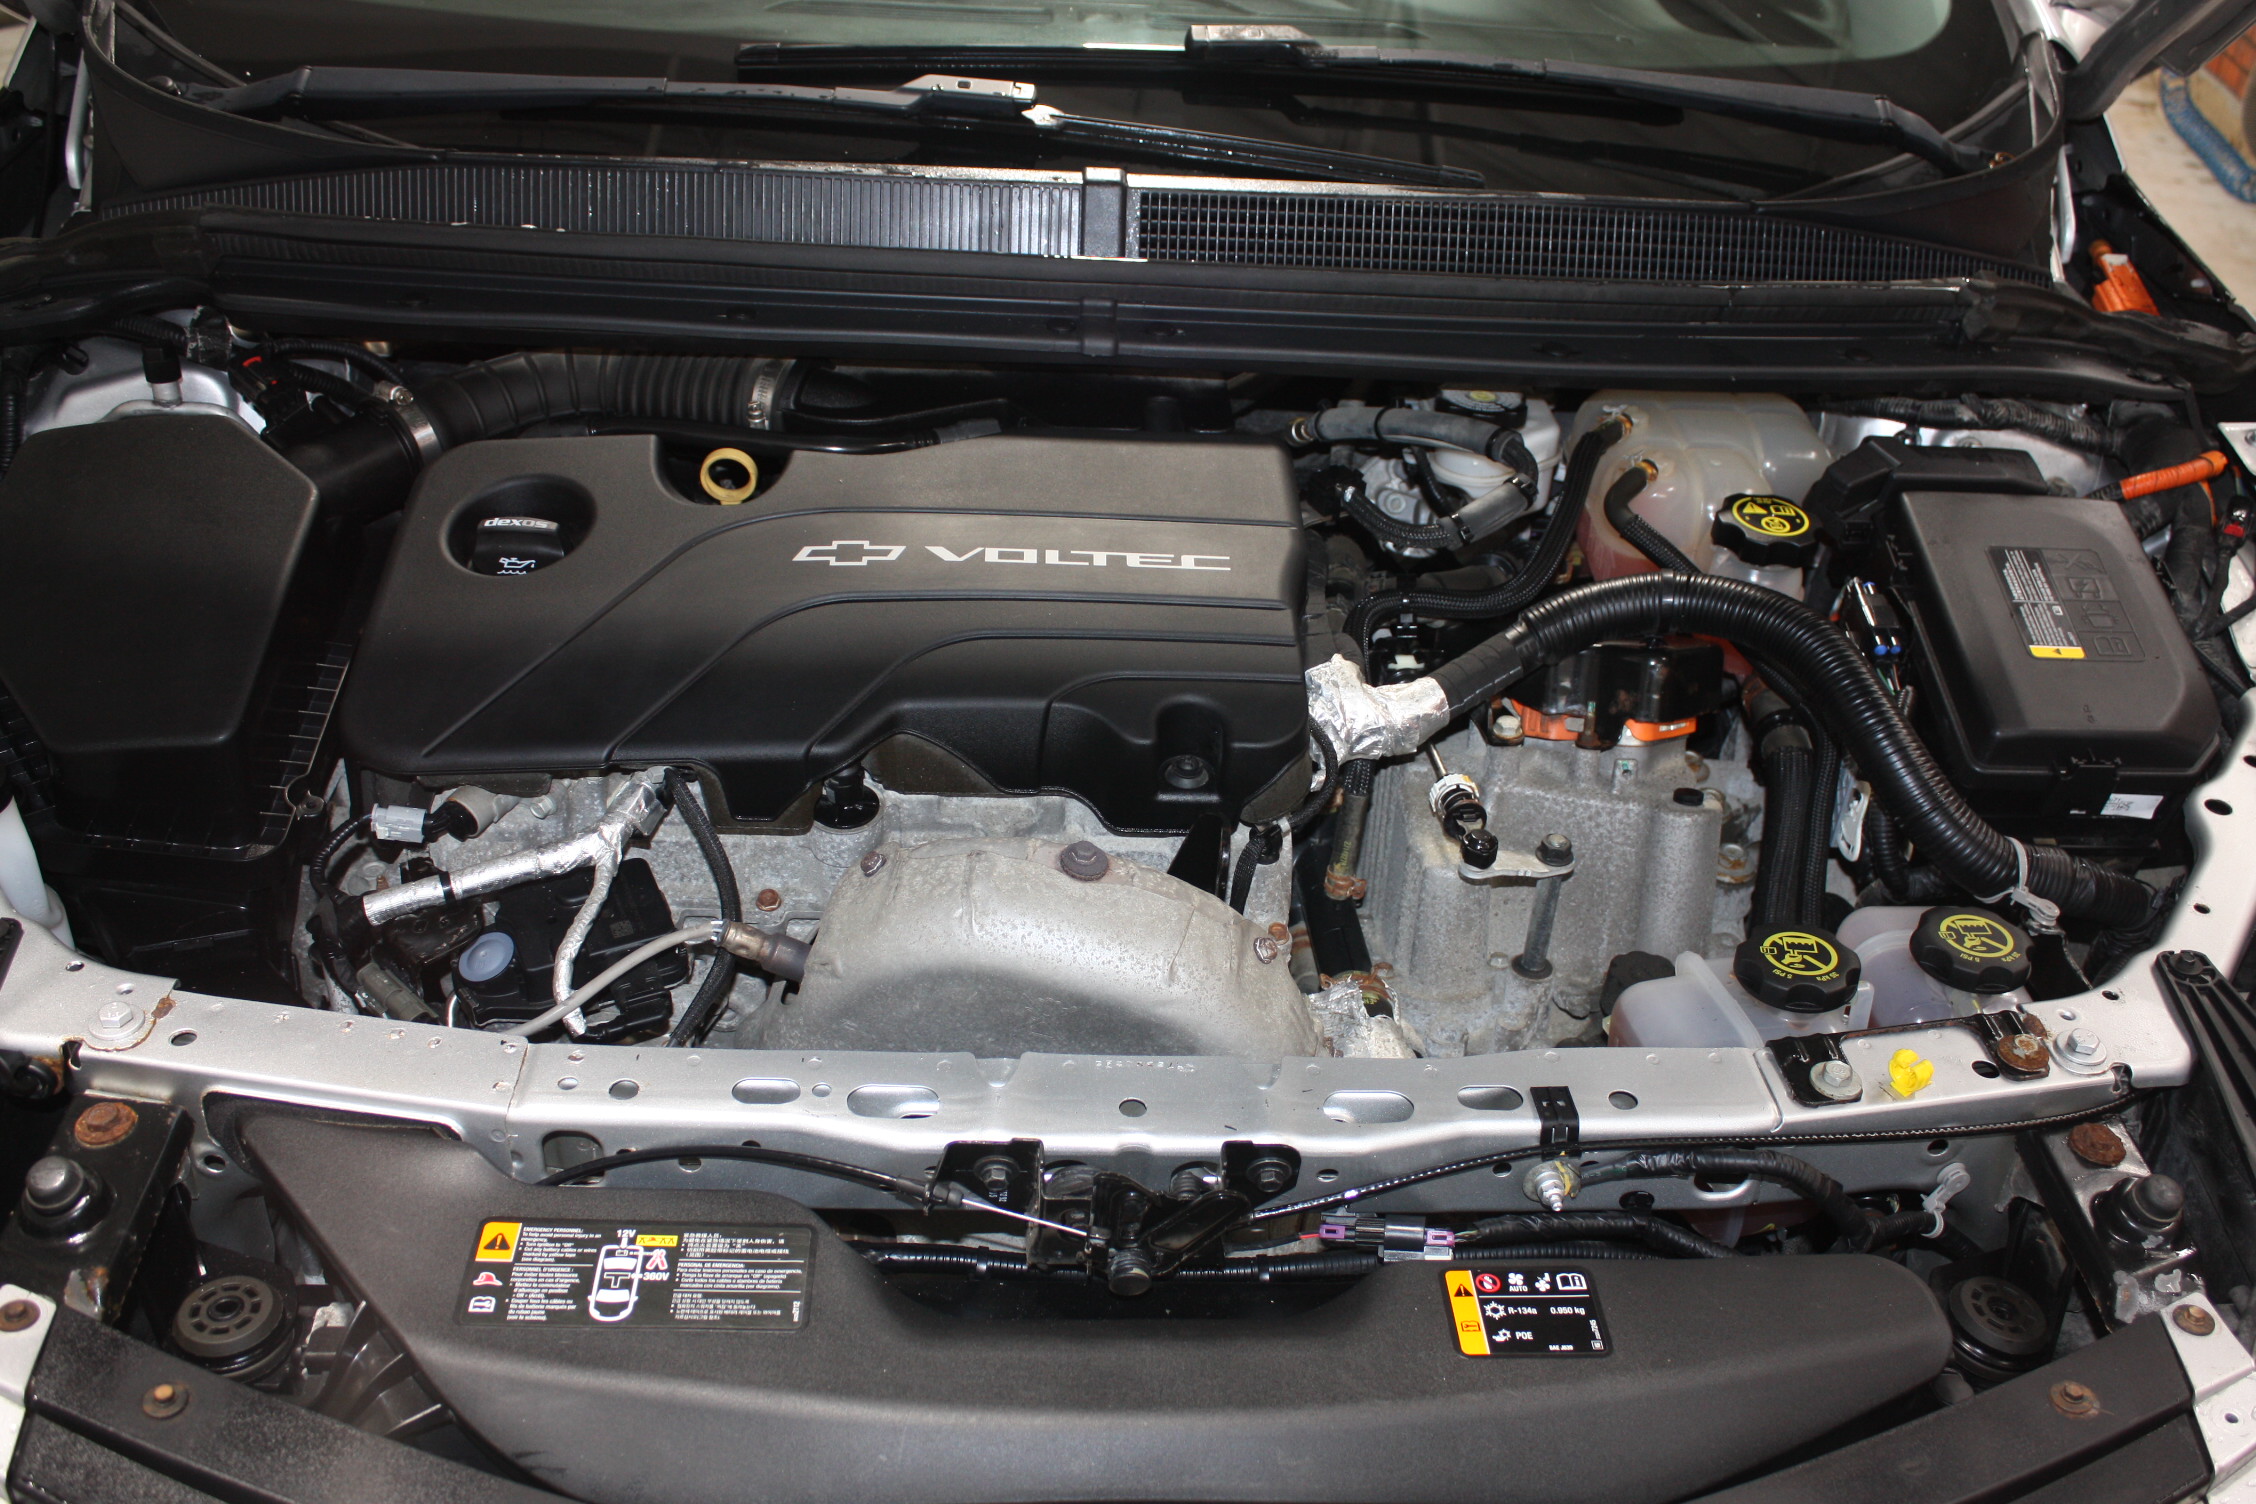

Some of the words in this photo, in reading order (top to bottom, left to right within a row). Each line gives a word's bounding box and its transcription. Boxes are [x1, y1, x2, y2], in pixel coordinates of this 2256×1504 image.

[484, 517, 548, 528] dexos
[924, 546, 1231, 570] VOLTEC
[1772, 968, 1786, 977] PSI
[616, 1229, 636, 1238] 12V
[1507, 1307, 1538, 1315] R-134a
[1550, 1307, 1573, 1315] 0.950
[1574, 1306, 1585, 1316] kg
[1515, 1331, 1534, 1340] POE
